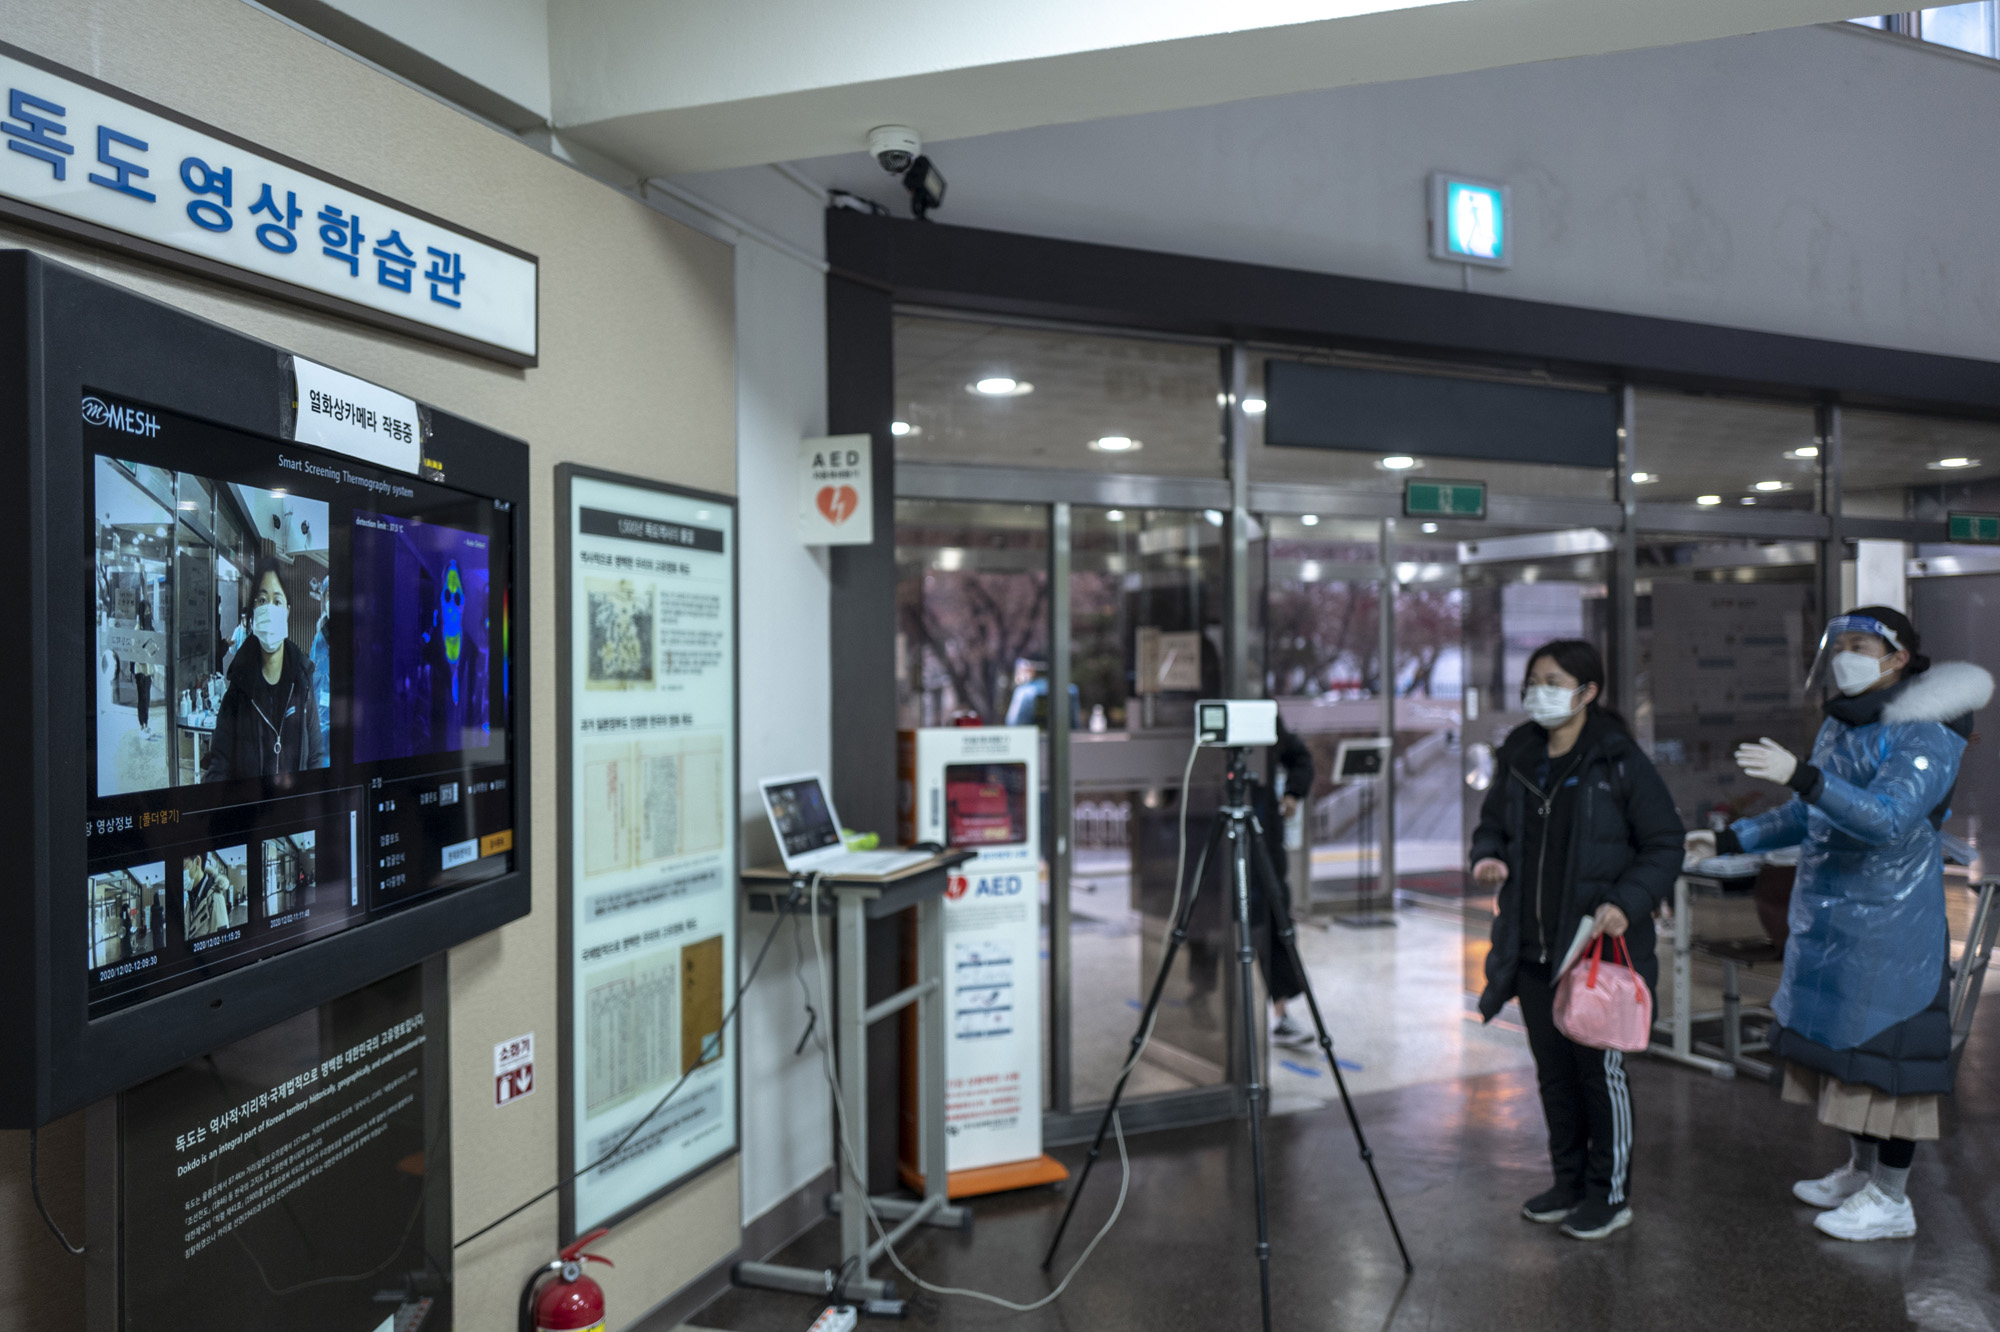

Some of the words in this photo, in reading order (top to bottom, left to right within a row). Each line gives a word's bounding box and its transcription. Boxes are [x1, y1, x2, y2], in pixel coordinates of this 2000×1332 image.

[107, 404, 161, 438] MESH
[309, 389, 377, 433] 열화상카메라
[382, 415, 413, 444] 작동중
[811, 449, 861, 468] AED
[278, 454, 303, 472] Smart
[304, 460, 341, 484] Screening
[342, 470, 392, 496] Thermography
[392, 484, 414, 499] system
[96, 816, 134, 834] 영상정보
[139, 809, 179, 829] [폴더열기]
[976, 875, 1022, 897] AED
[193, 930, 241, 952] 2020/12/02-11:15:29
[100, 955, 157, 982] 2020/12/02-12:09:30
[500, 1039, 530, 1061] 소화기
[175, 1127, 206, 1151] 독도는
[321, 1054, 343, 1077] 명백한
[345, 1035, 379, 1063] 대한민국의
[177, 1158, 200, 1176] Dokdo
[201, 1153, 207, 1164] is
[208, 1149, 218, 1160] an
[218, 1132, 243, 1154] integral
[243, 1126, 257, 1142] part
[257, 1120, 265, 1132] of
[265, 1111, 285, 1128] Korean
[286, 1099, 308, 1116] territory
